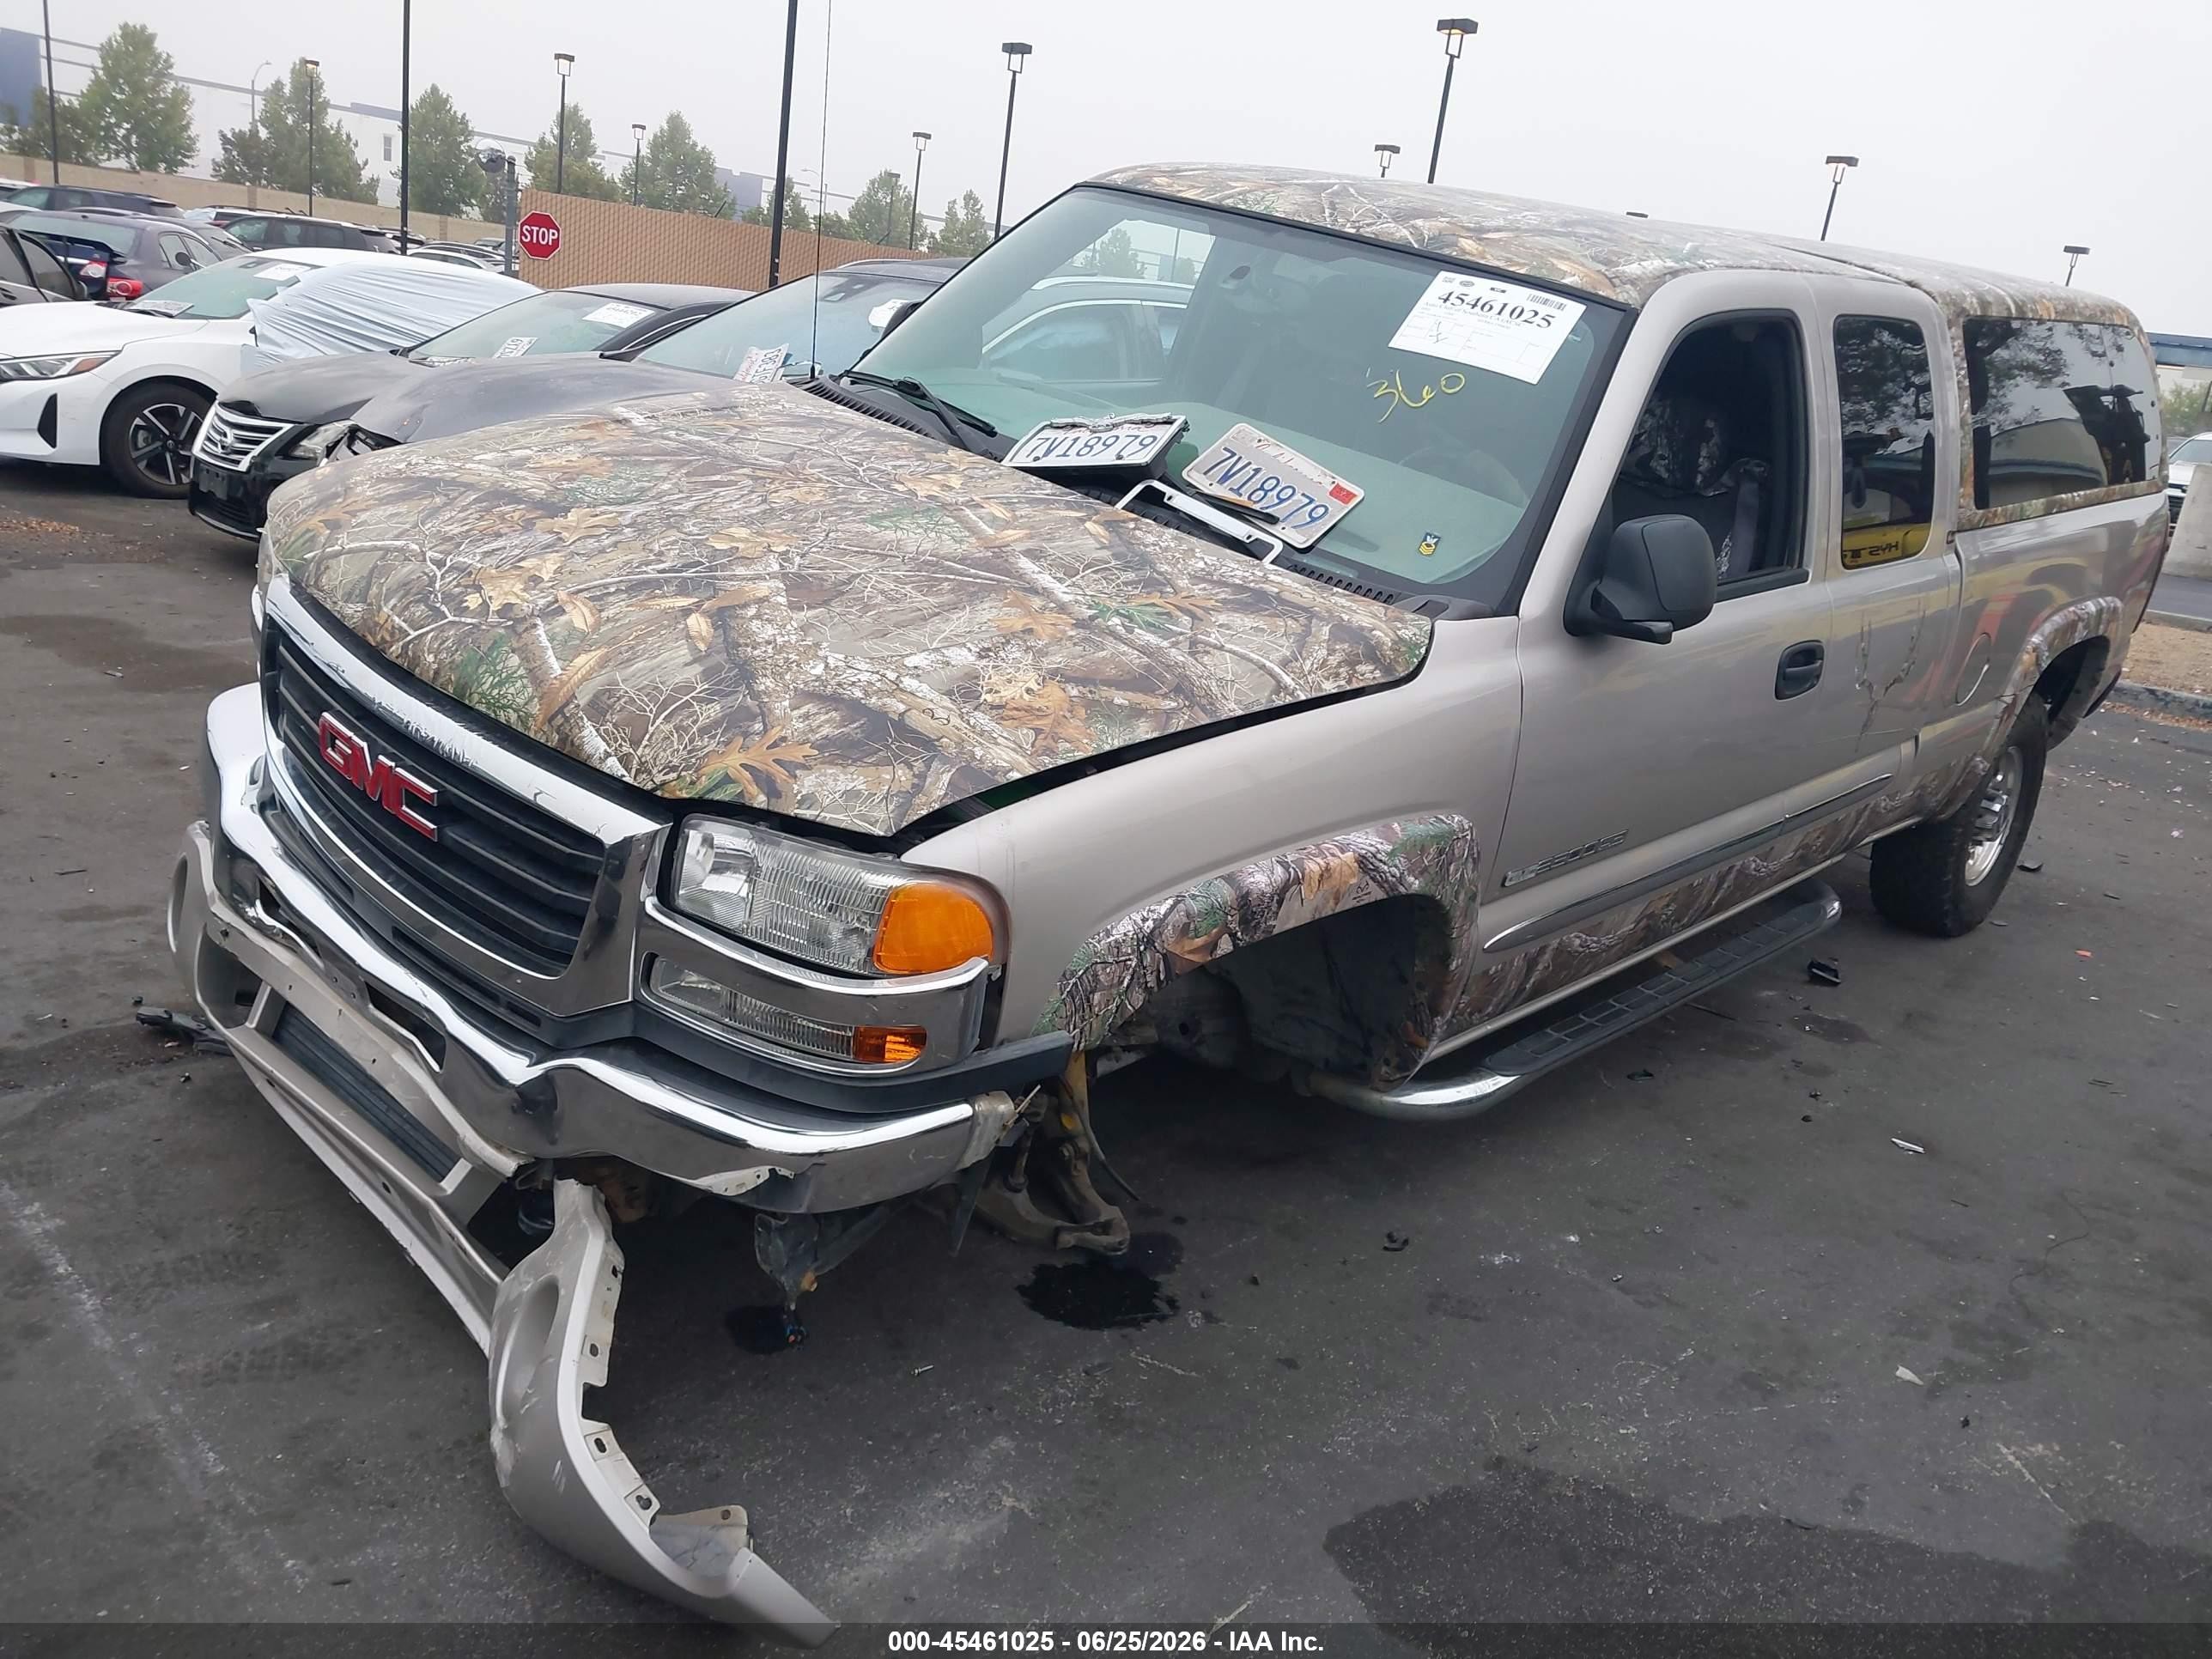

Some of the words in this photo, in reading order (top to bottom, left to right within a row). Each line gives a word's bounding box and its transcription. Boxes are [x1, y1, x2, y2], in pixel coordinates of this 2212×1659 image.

[521, 225, 558, 246] STOP
[1438, 290, 1557, 329] 45461025
[1367, 370, 1466, 422] 360
[1026, 435, 1158, 459] 7V18979
[1202, 446, 1330, 530] 7V18979
[319, 711, 439, 842] GMC
